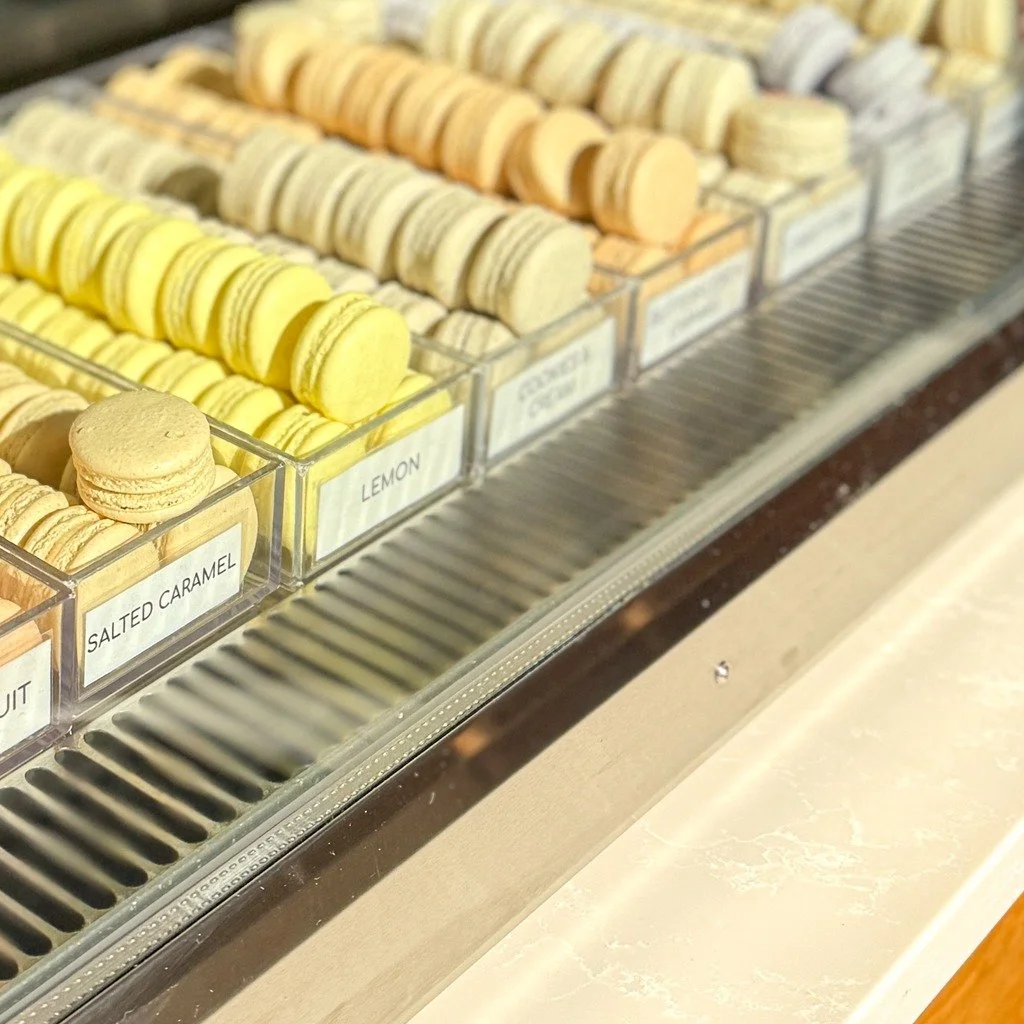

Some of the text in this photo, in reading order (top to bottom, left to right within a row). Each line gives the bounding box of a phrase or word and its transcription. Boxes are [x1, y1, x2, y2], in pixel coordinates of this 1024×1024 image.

[361, 451, 421, 503] LEMON
[87, 552, 237, 654] SALTED CARAMEL
